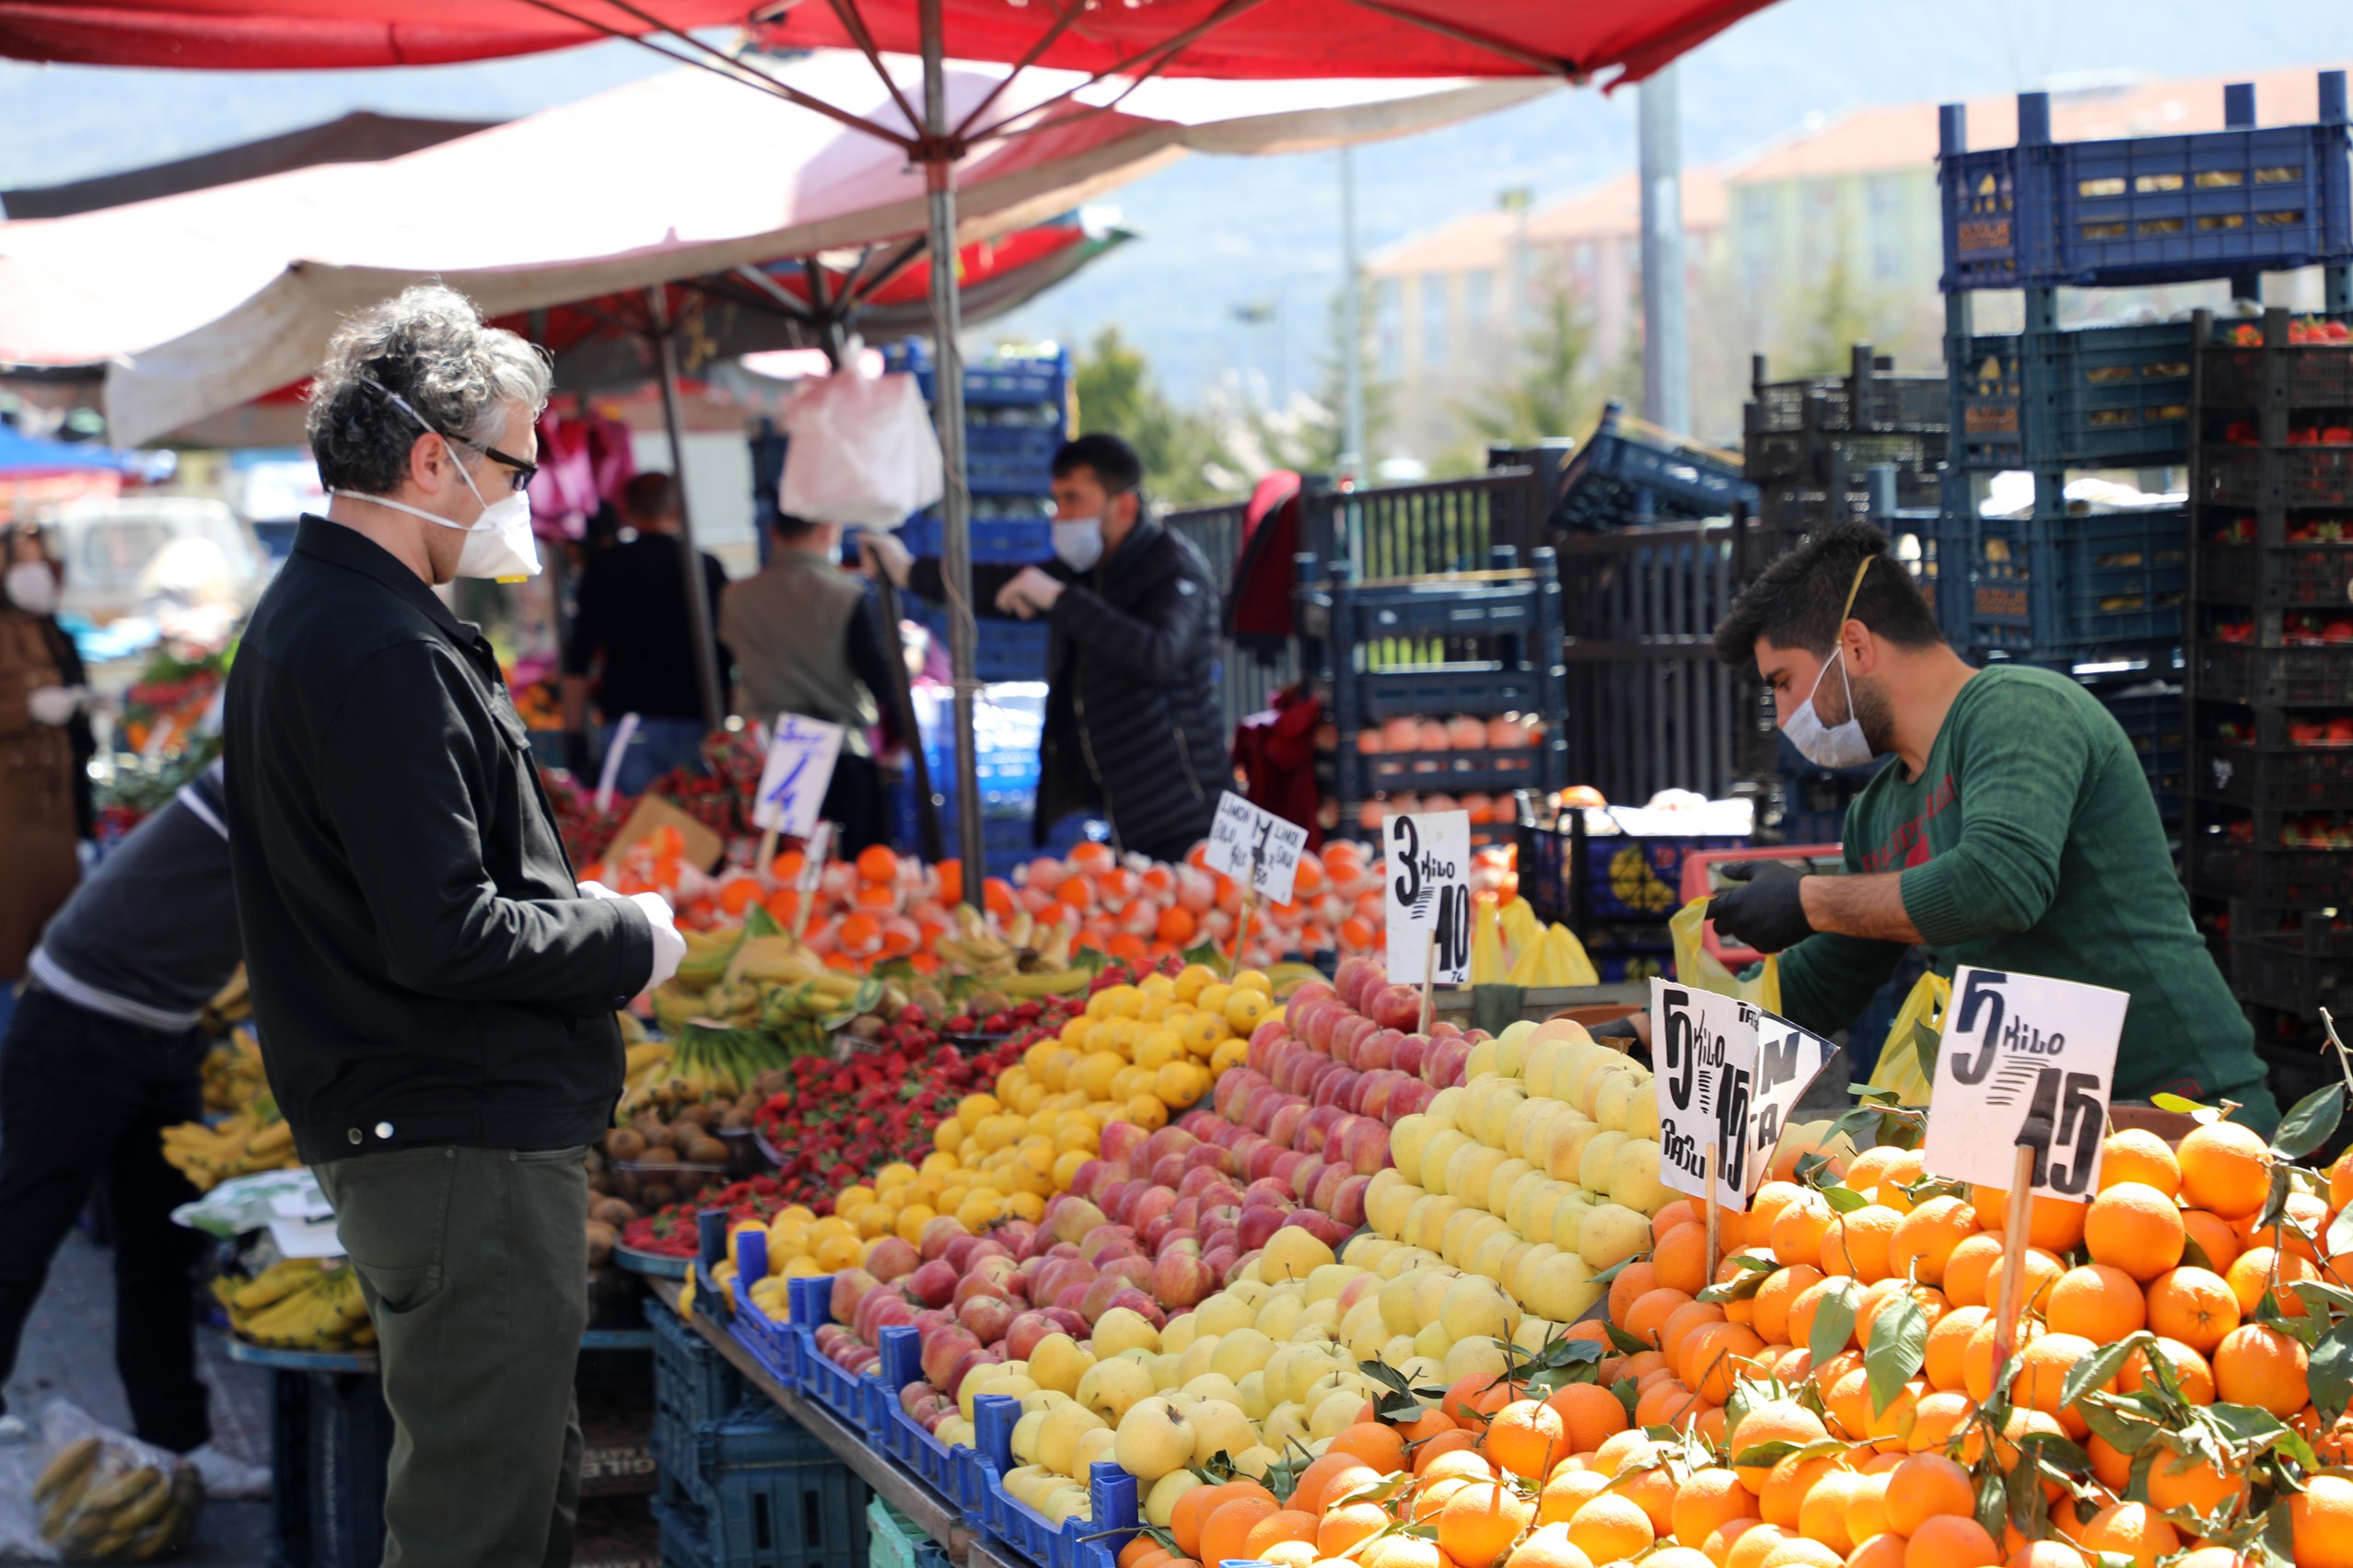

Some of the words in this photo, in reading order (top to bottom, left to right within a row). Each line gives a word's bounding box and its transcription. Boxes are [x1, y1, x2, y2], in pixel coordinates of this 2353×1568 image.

[1393, 816, 1420, 906] 3
[1662, 988, 1693, 1111] 5
[1951, 970, 2008, 1086] 5
